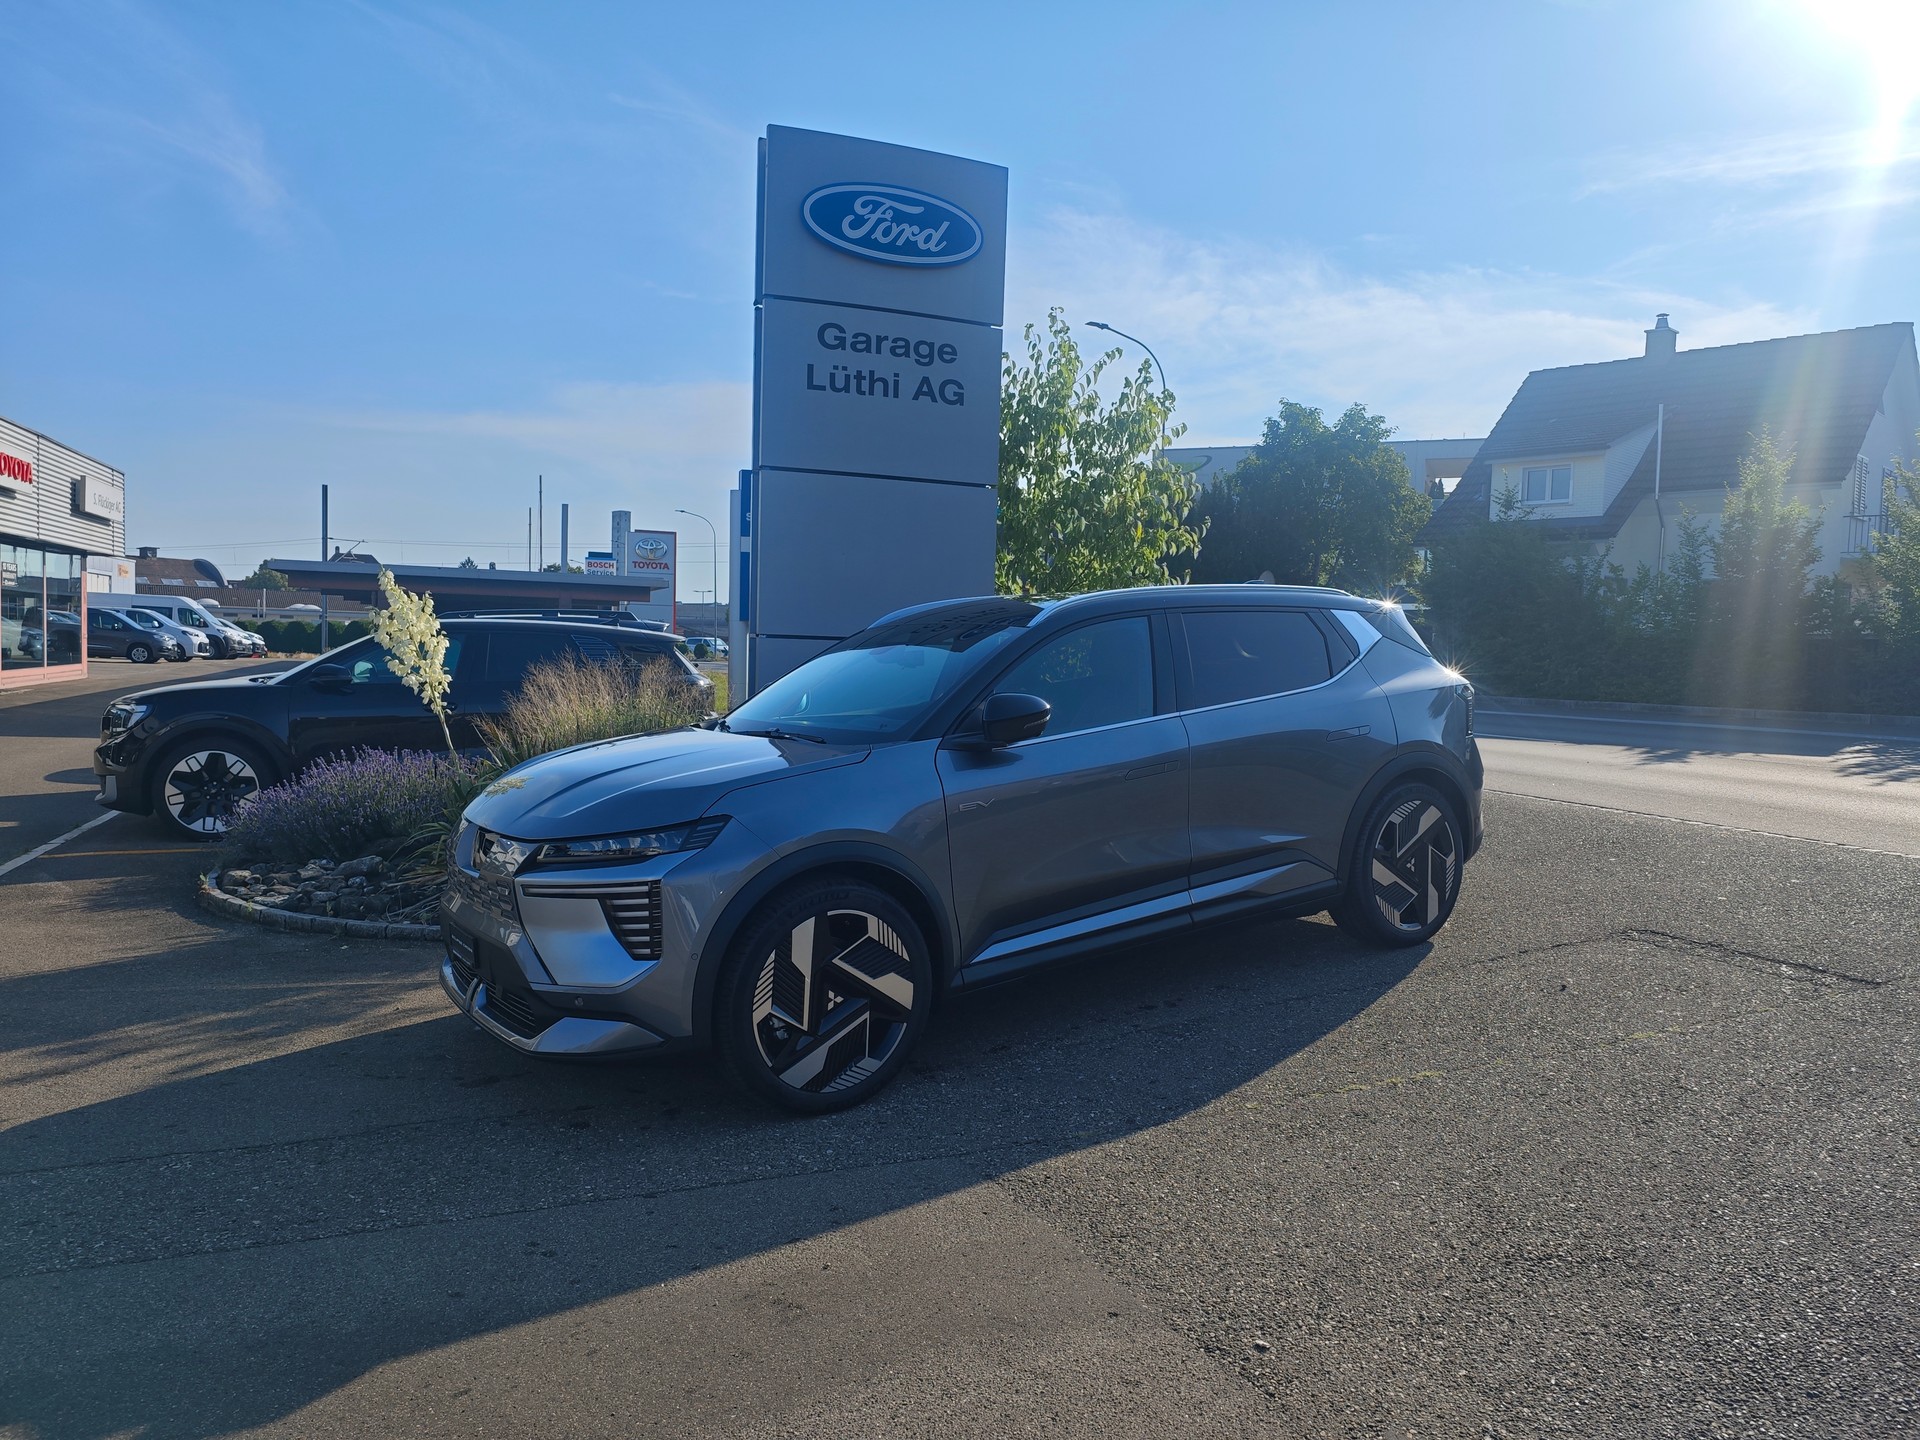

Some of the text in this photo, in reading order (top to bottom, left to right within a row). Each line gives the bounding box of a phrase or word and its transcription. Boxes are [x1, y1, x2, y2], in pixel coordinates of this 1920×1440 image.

[842, 195, 950, 252] Ford
[816, 322, 958, 367] Garage
[806, 363, 965, 407] Lüthi AG
[0, 452, 32, 484] OYOTA
[587, 561, 614, 569] BOSCH
[632, 561, 670, 570] TOYOTA
[960, 798, 995, 811] EV
